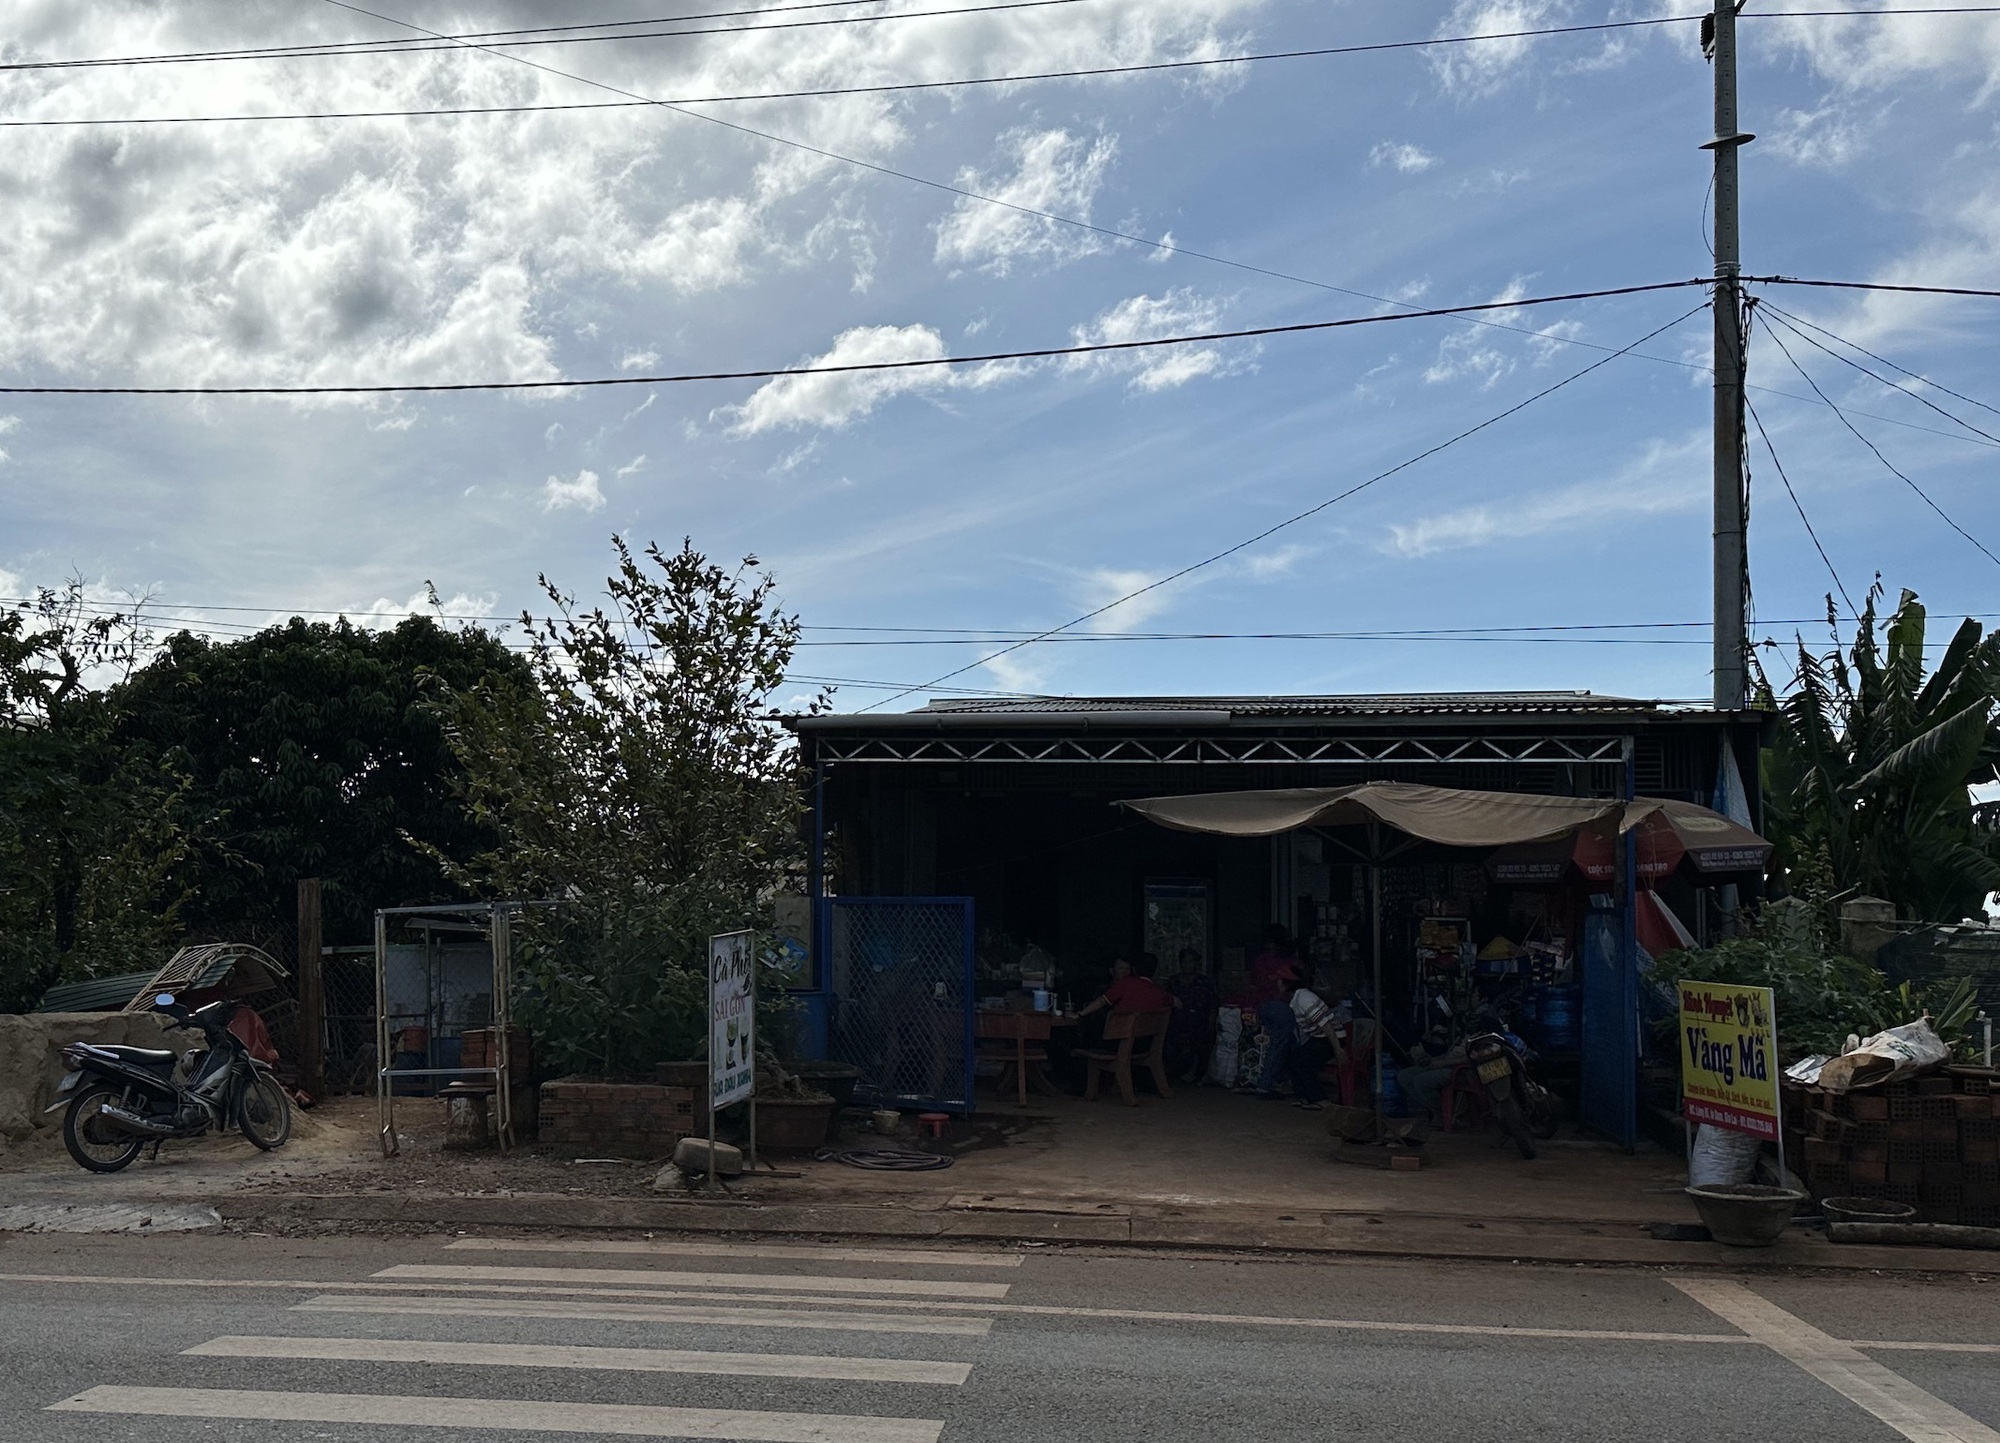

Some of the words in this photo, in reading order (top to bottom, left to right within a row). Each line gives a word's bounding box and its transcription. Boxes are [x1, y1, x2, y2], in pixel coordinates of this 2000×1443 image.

[714, 954, 728, 984] Cà
[1687, 1027, 1733, 1085] Vàng
[1738, 1034, 1767, 1082] Mã
